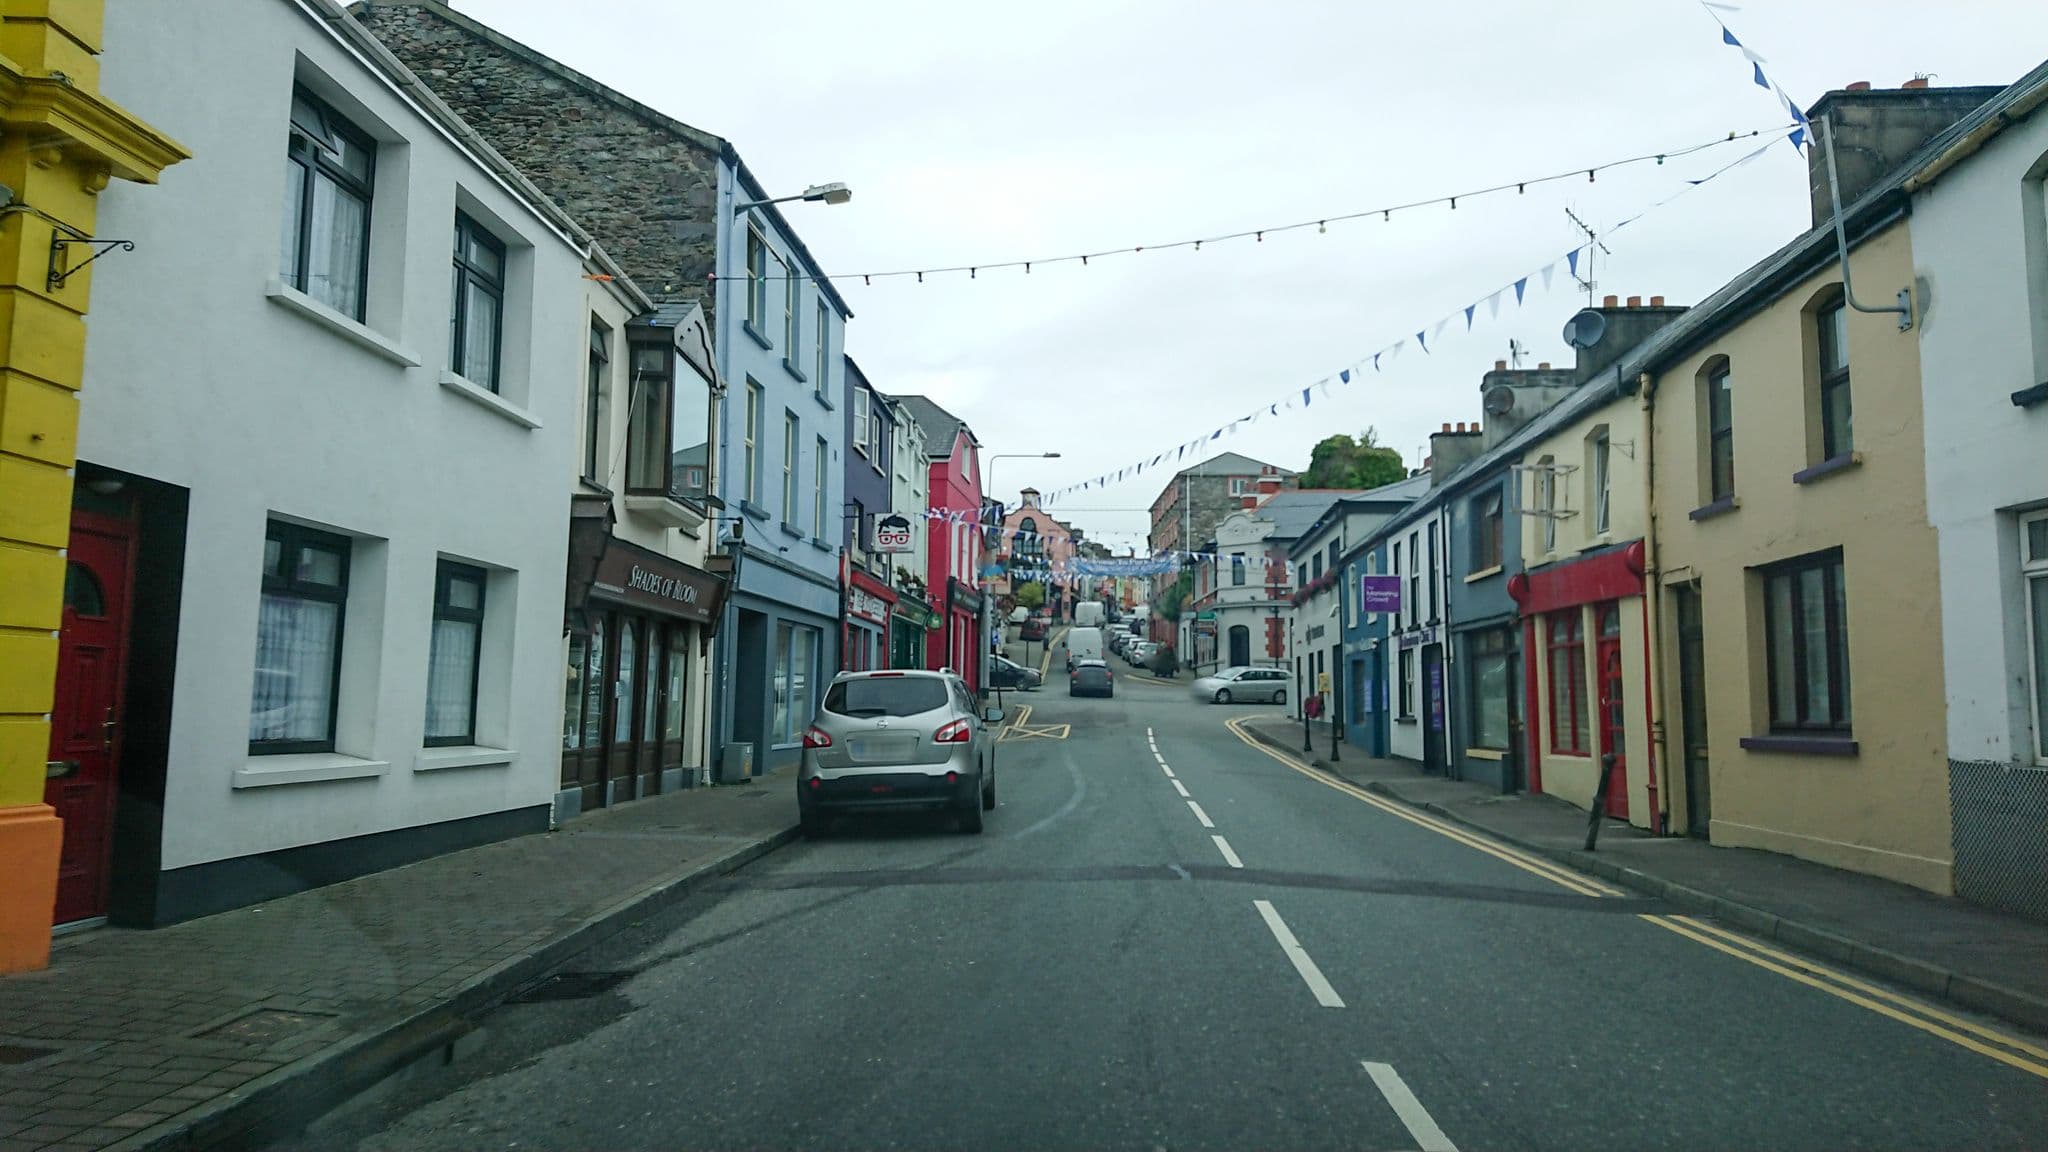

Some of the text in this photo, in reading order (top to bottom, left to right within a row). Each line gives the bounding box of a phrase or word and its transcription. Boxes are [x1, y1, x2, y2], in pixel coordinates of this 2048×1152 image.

[628, 565, 663, 594] SHADES
[661, 579, 674, 598] OF
[672, 579, 698, 605] BLOOM
